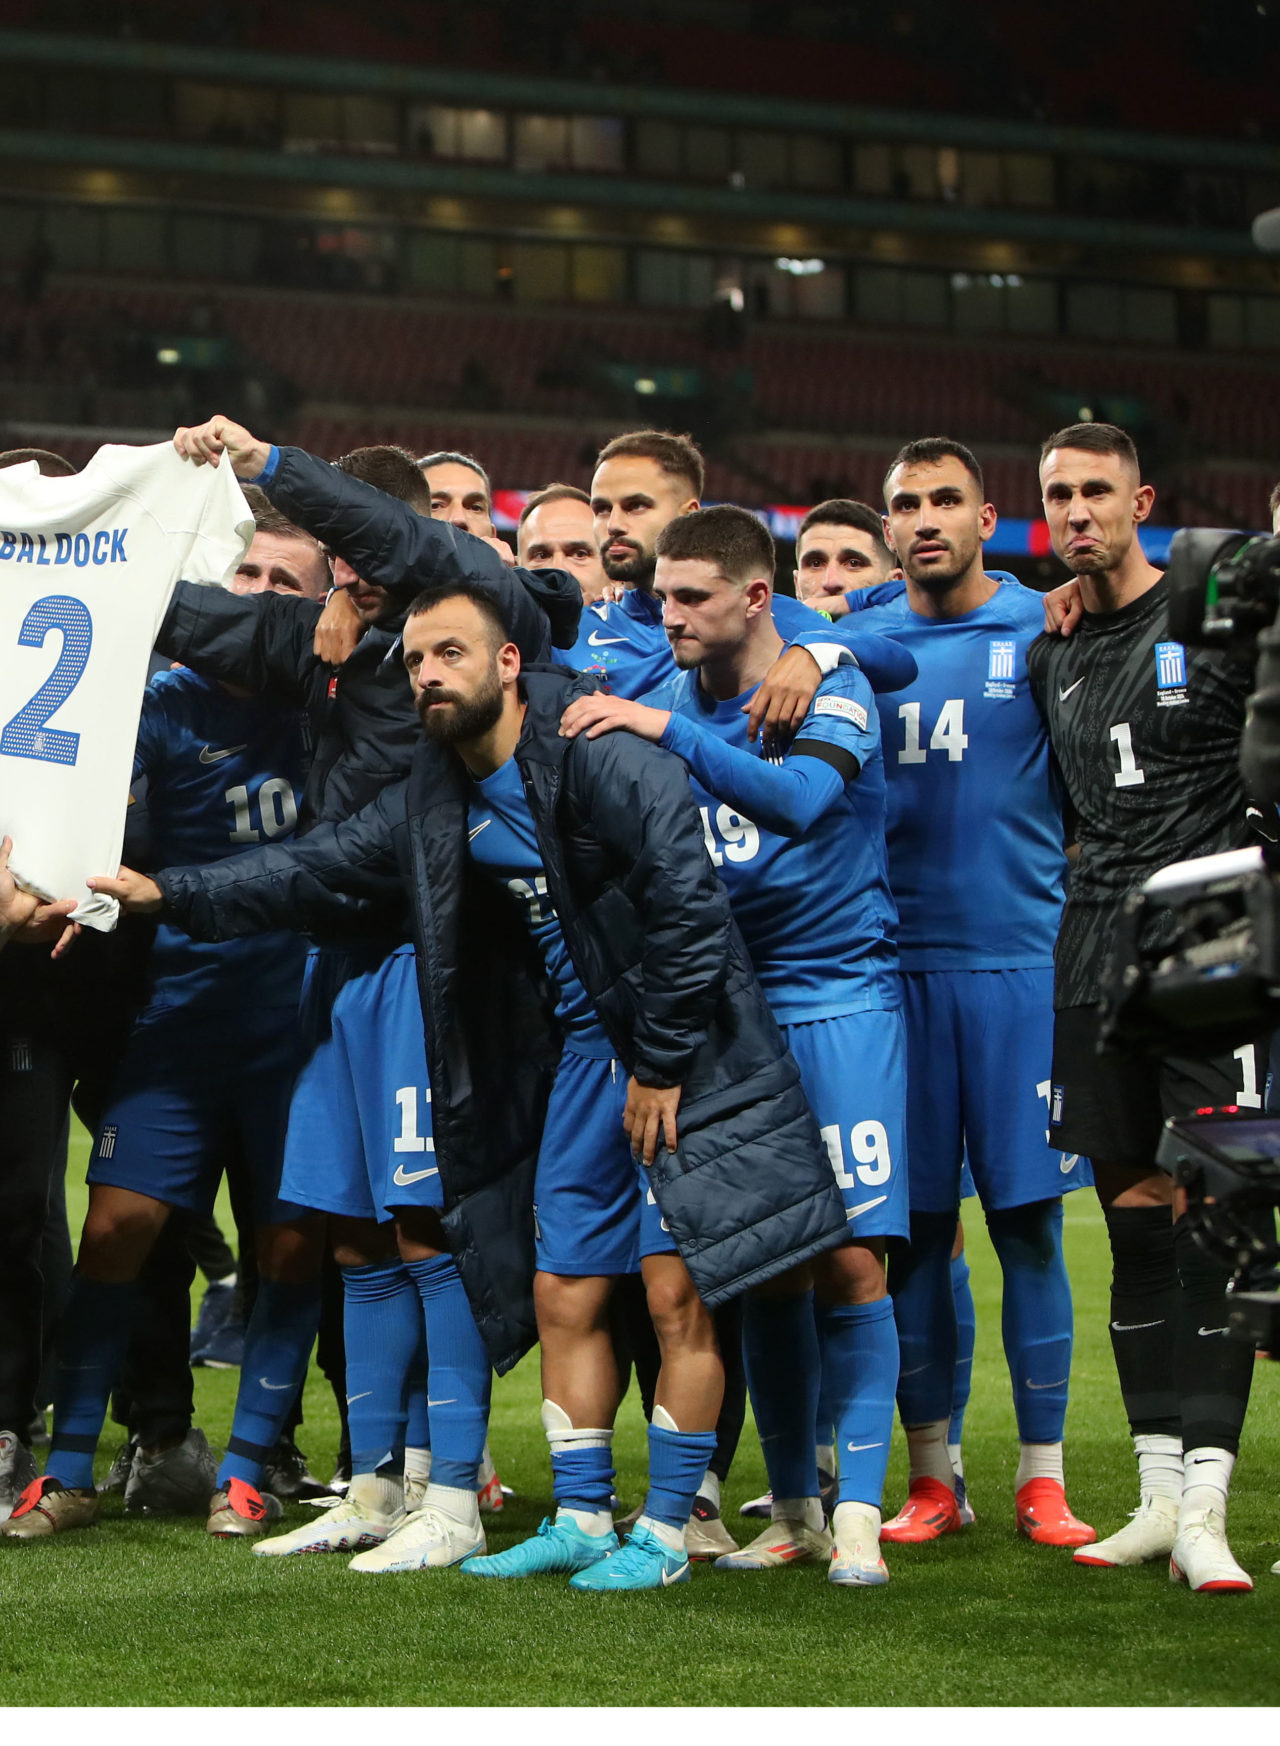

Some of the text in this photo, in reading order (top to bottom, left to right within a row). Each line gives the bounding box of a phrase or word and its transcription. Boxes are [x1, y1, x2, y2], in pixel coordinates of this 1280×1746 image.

[0, 595, 93, 766] 2
[898, 699, 968, 764] 14
[1109, 722, 1145, 788] 1
[225, 777, 298, 843] 10
[1233, 1044, 1261, 1108] 1
[819, 1120, 892, 1190] 19
